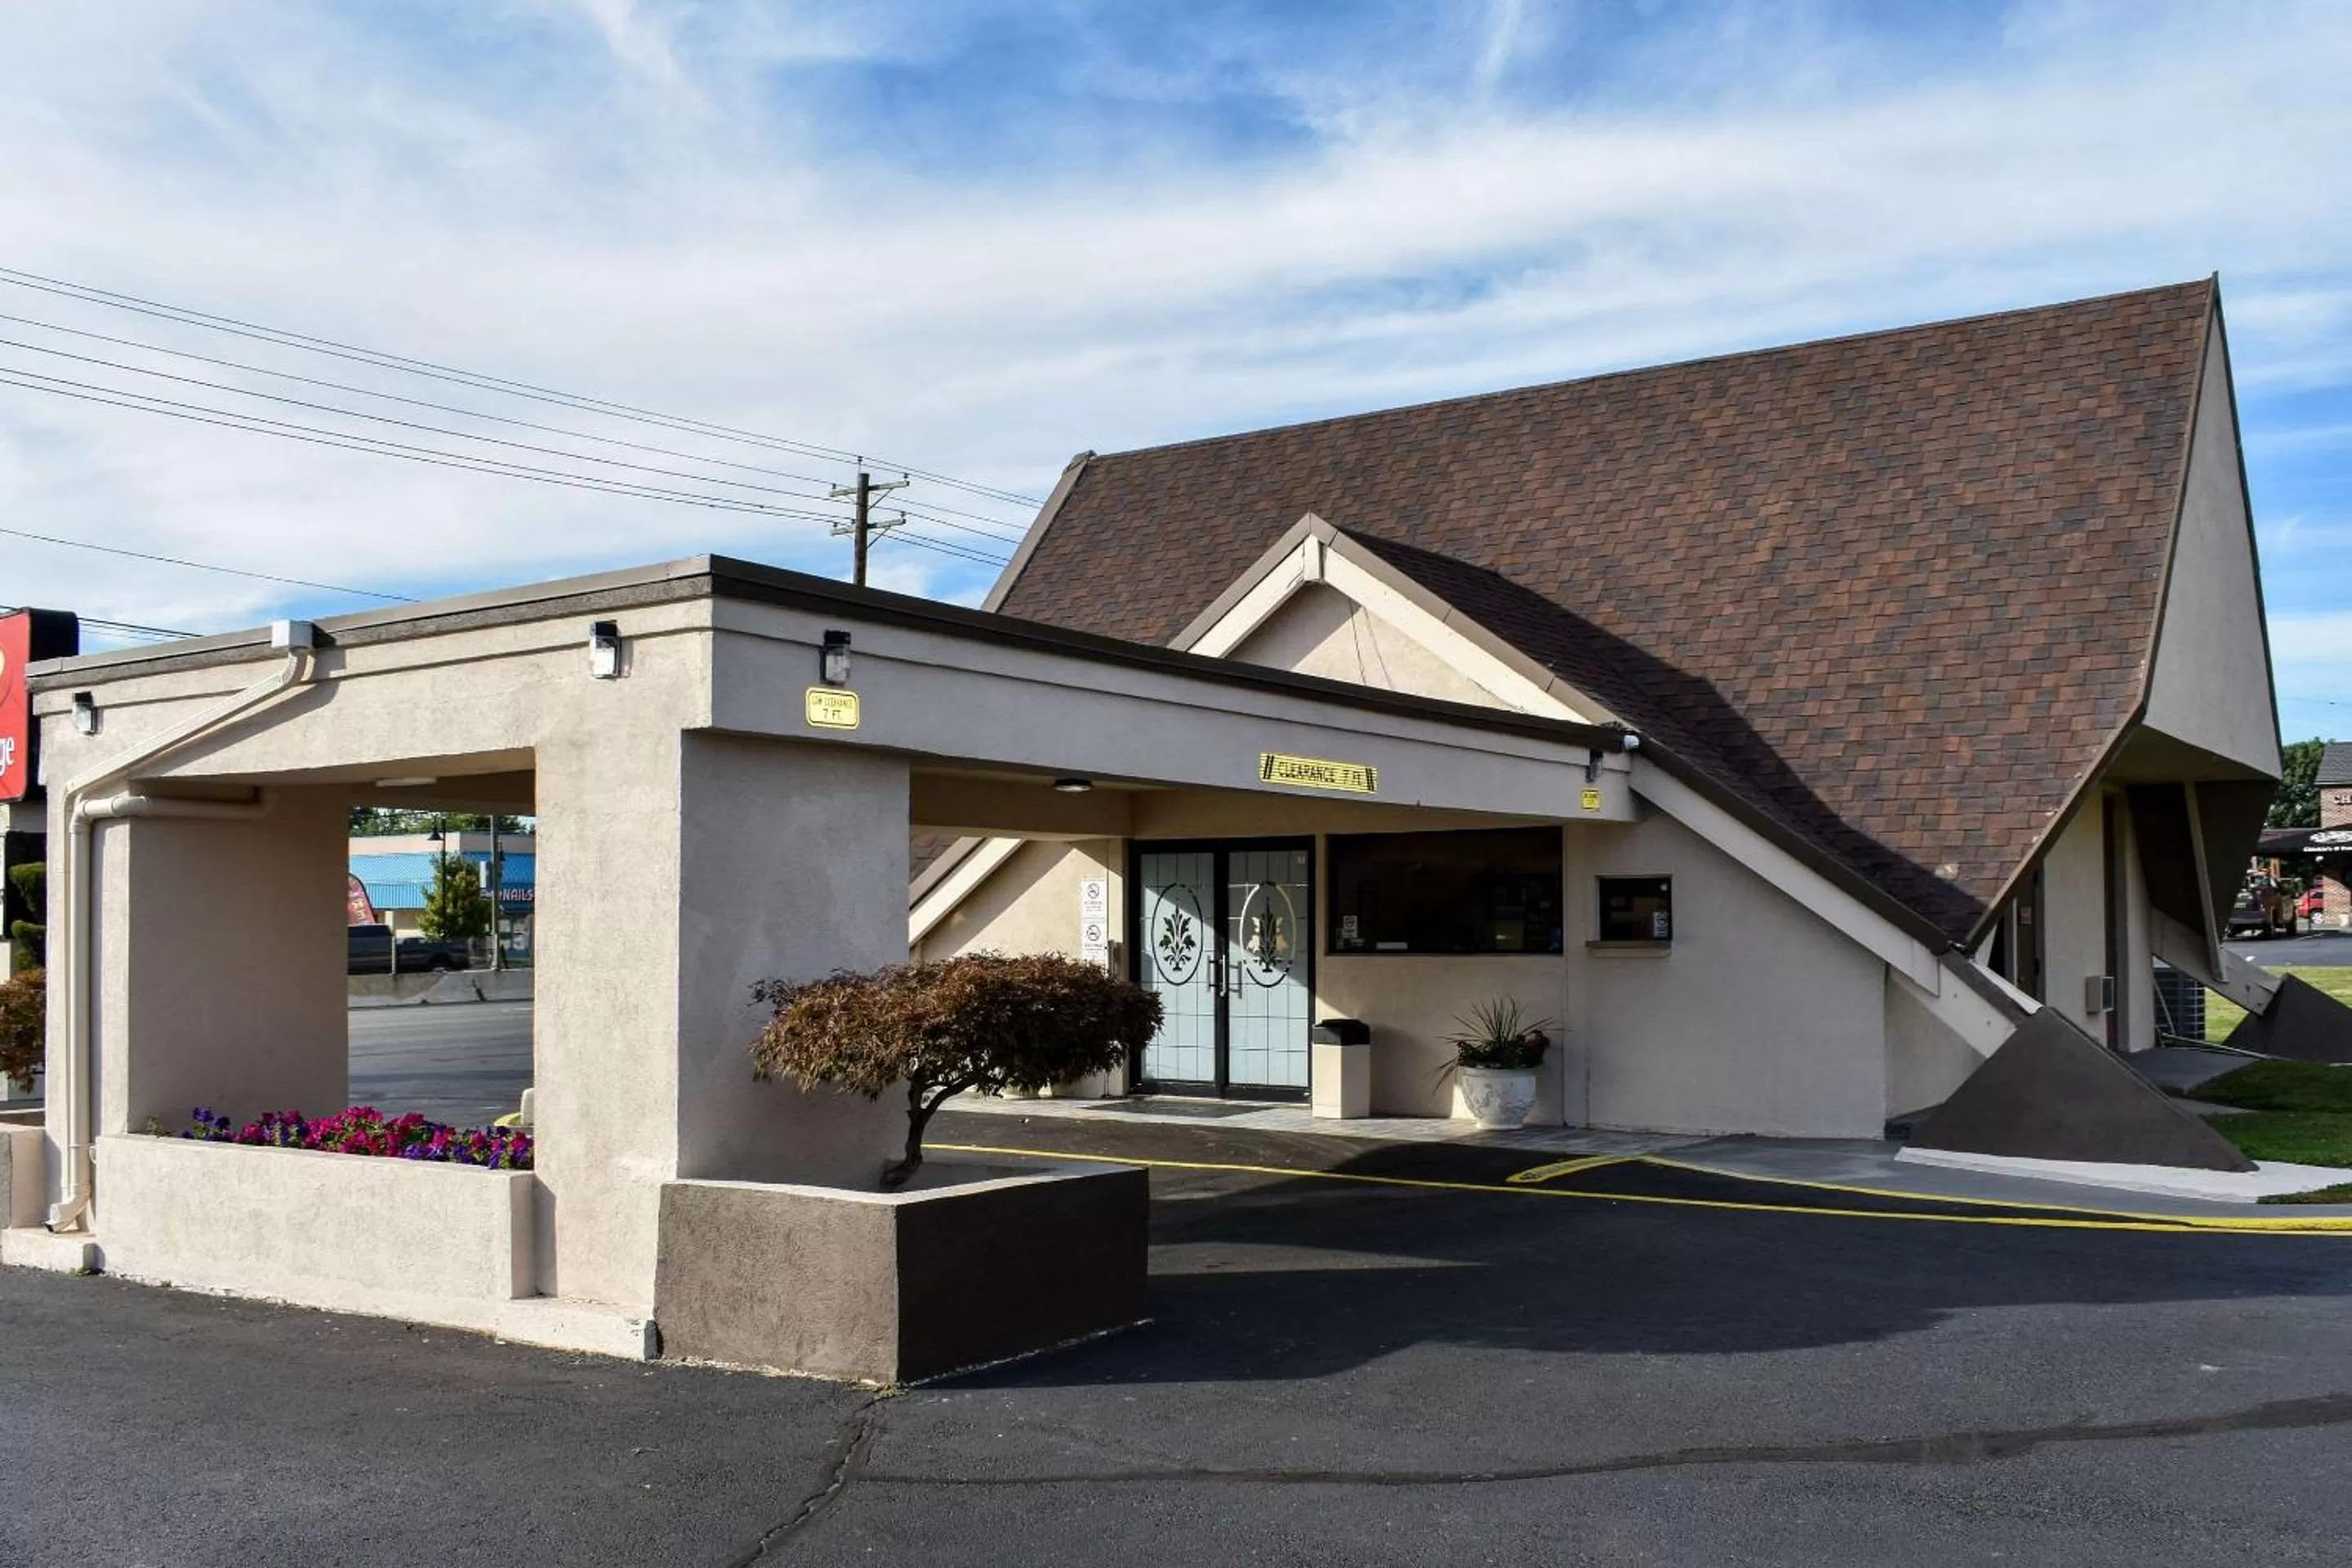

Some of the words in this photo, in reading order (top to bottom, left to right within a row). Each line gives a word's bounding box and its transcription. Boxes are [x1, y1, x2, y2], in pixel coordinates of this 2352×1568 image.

[822, 708, 828, 719] 7
[1277, 761, 1336, 783] CLEARANCE
[503, 888, 532, 902] NAILS
